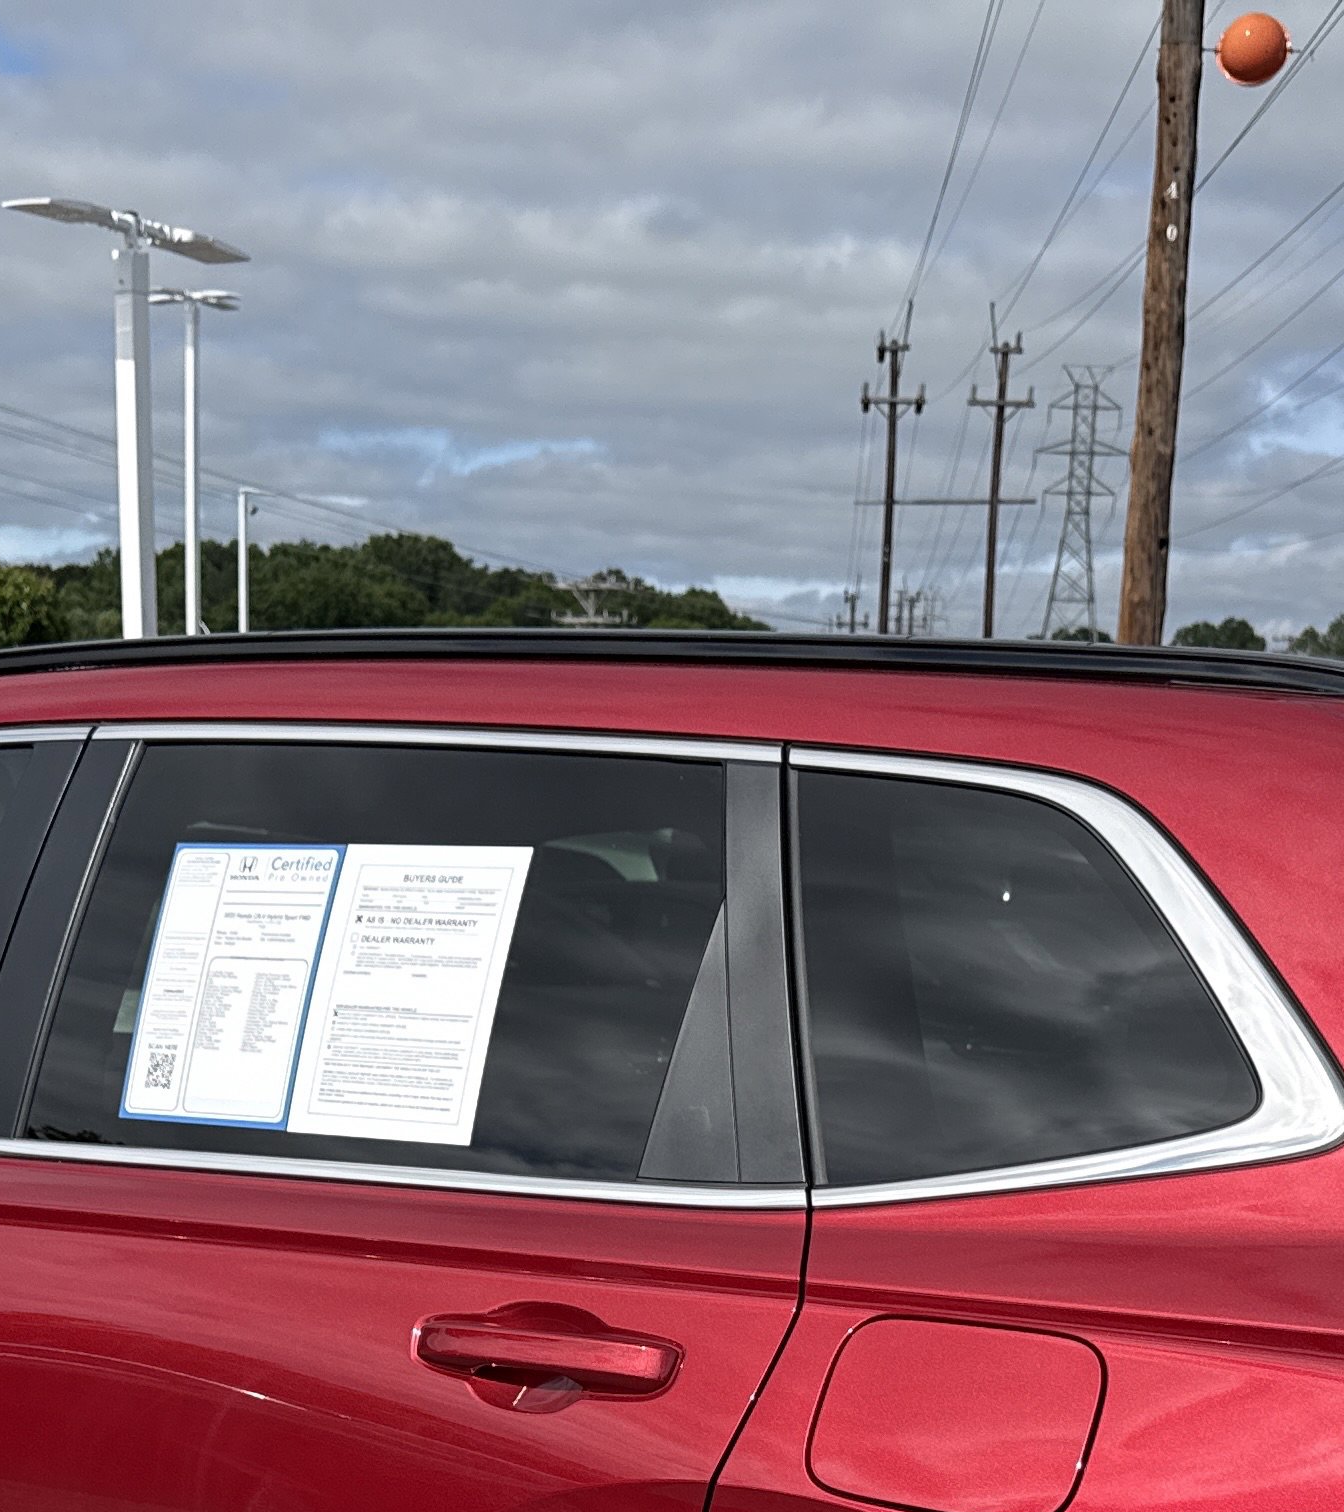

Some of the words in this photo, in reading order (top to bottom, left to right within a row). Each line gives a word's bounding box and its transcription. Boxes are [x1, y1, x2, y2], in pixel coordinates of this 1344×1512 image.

[271, 856, 333, 871] Certified
[403, 874, 437, 883] BUYERS
[437, 875, 464, 884] GUIDE
[366, 916, 376, 924] AS
[390, 917, 401, 925] NO
[403, 917, 433, 926] DEALER
[434, 918, 478, 928] WARRANTY
[361, 934, 391, 944] DEALER
[392, 935, 435, 945] WARRANTY
